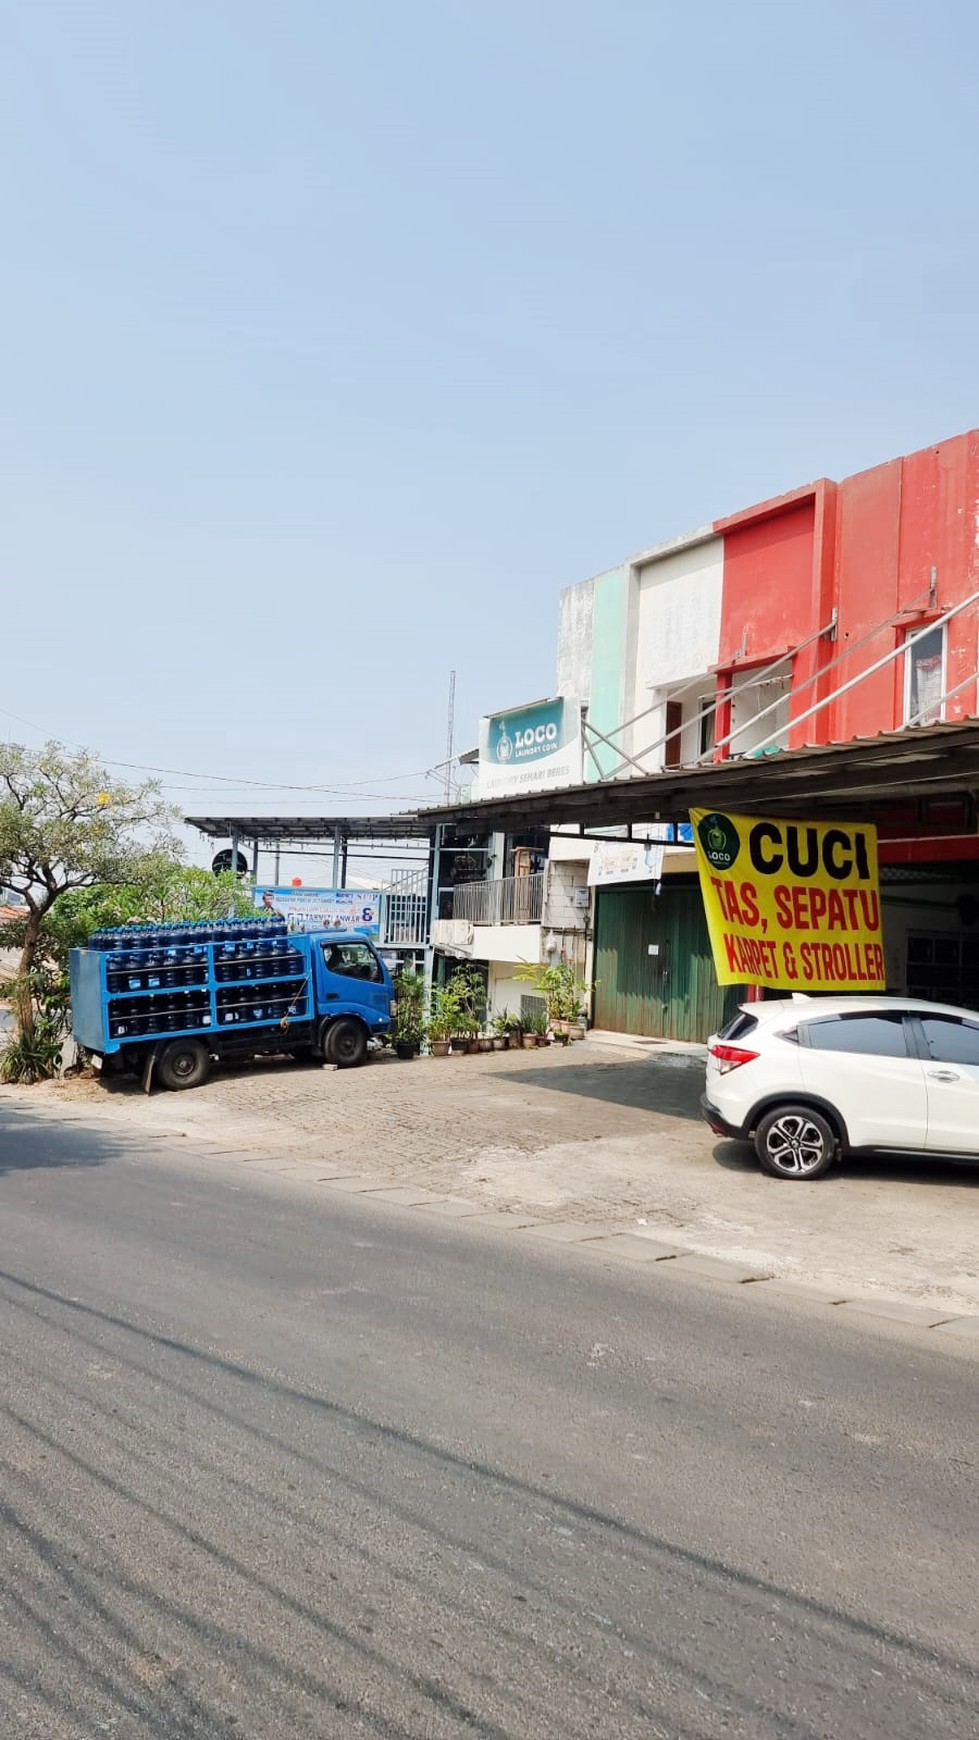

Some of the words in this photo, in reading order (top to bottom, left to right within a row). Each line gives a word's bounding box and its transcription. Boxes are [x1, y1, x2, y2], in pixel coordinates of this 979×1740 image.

[515, 723, 557, 747] LOCO
[515, 747, 540, 757] LAUNDRY
[542, 742, 557, 751] COIN
[519, 770, 545, 783] SEHARI
[547, 765, 570, 777] BERES
[707, 851, 731, 861] LOCO
[749, 822, 871, 880] CUCI
[711, 876, 768, 934] TAS,
[773, 885, 880, 932] SEPATU
[723, 933, 779, 979] KARPET
[783, 941, 799, 980] &
[800, 942, 885, 981] STROLLER
